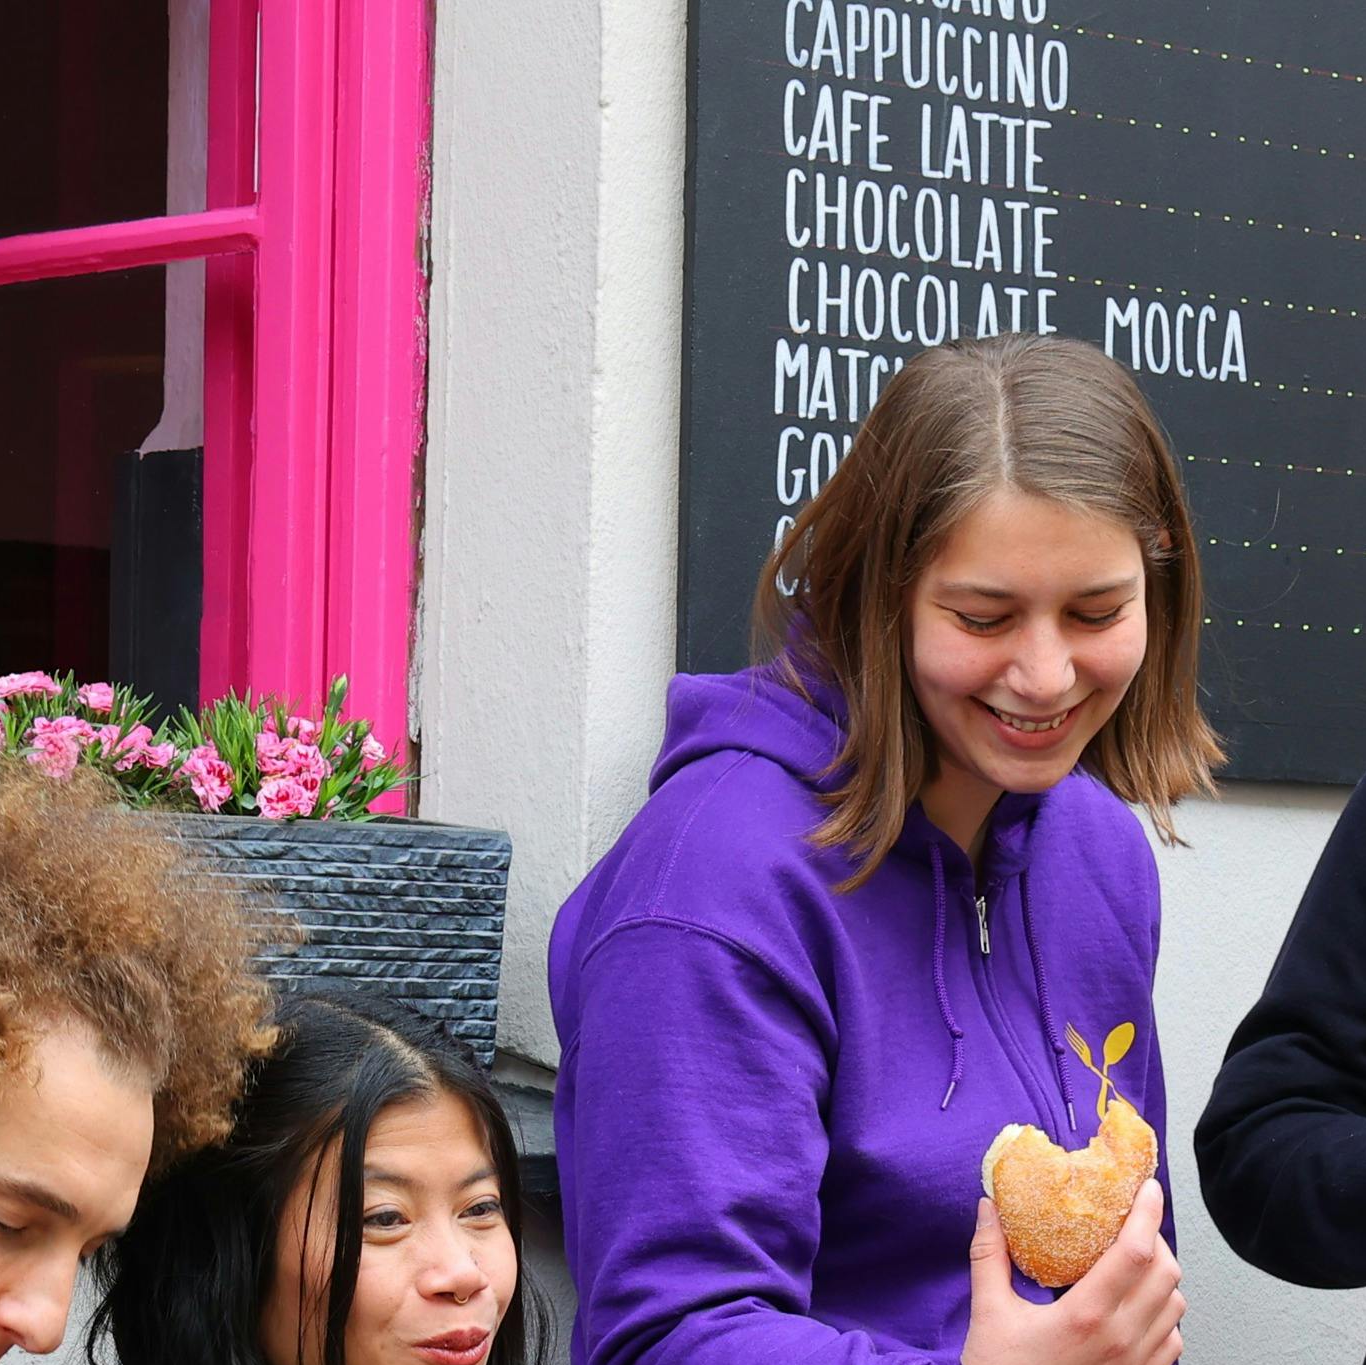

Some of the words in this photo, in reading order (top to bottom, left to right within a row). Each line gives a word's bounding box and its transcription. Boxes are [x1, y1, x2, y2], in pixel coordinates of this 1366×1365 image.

[784, 0, 1069, 112] CAPPUCCINO
[783, 79, 893, 172] CAFE
[921, 103, 1052, 194] LATTE
[785, 168, 1059, 278] CHOCOLATE
[788, 257, 1058, 347] CHOCOLATE
[1104, 297, 1248, 382] MOCCA
